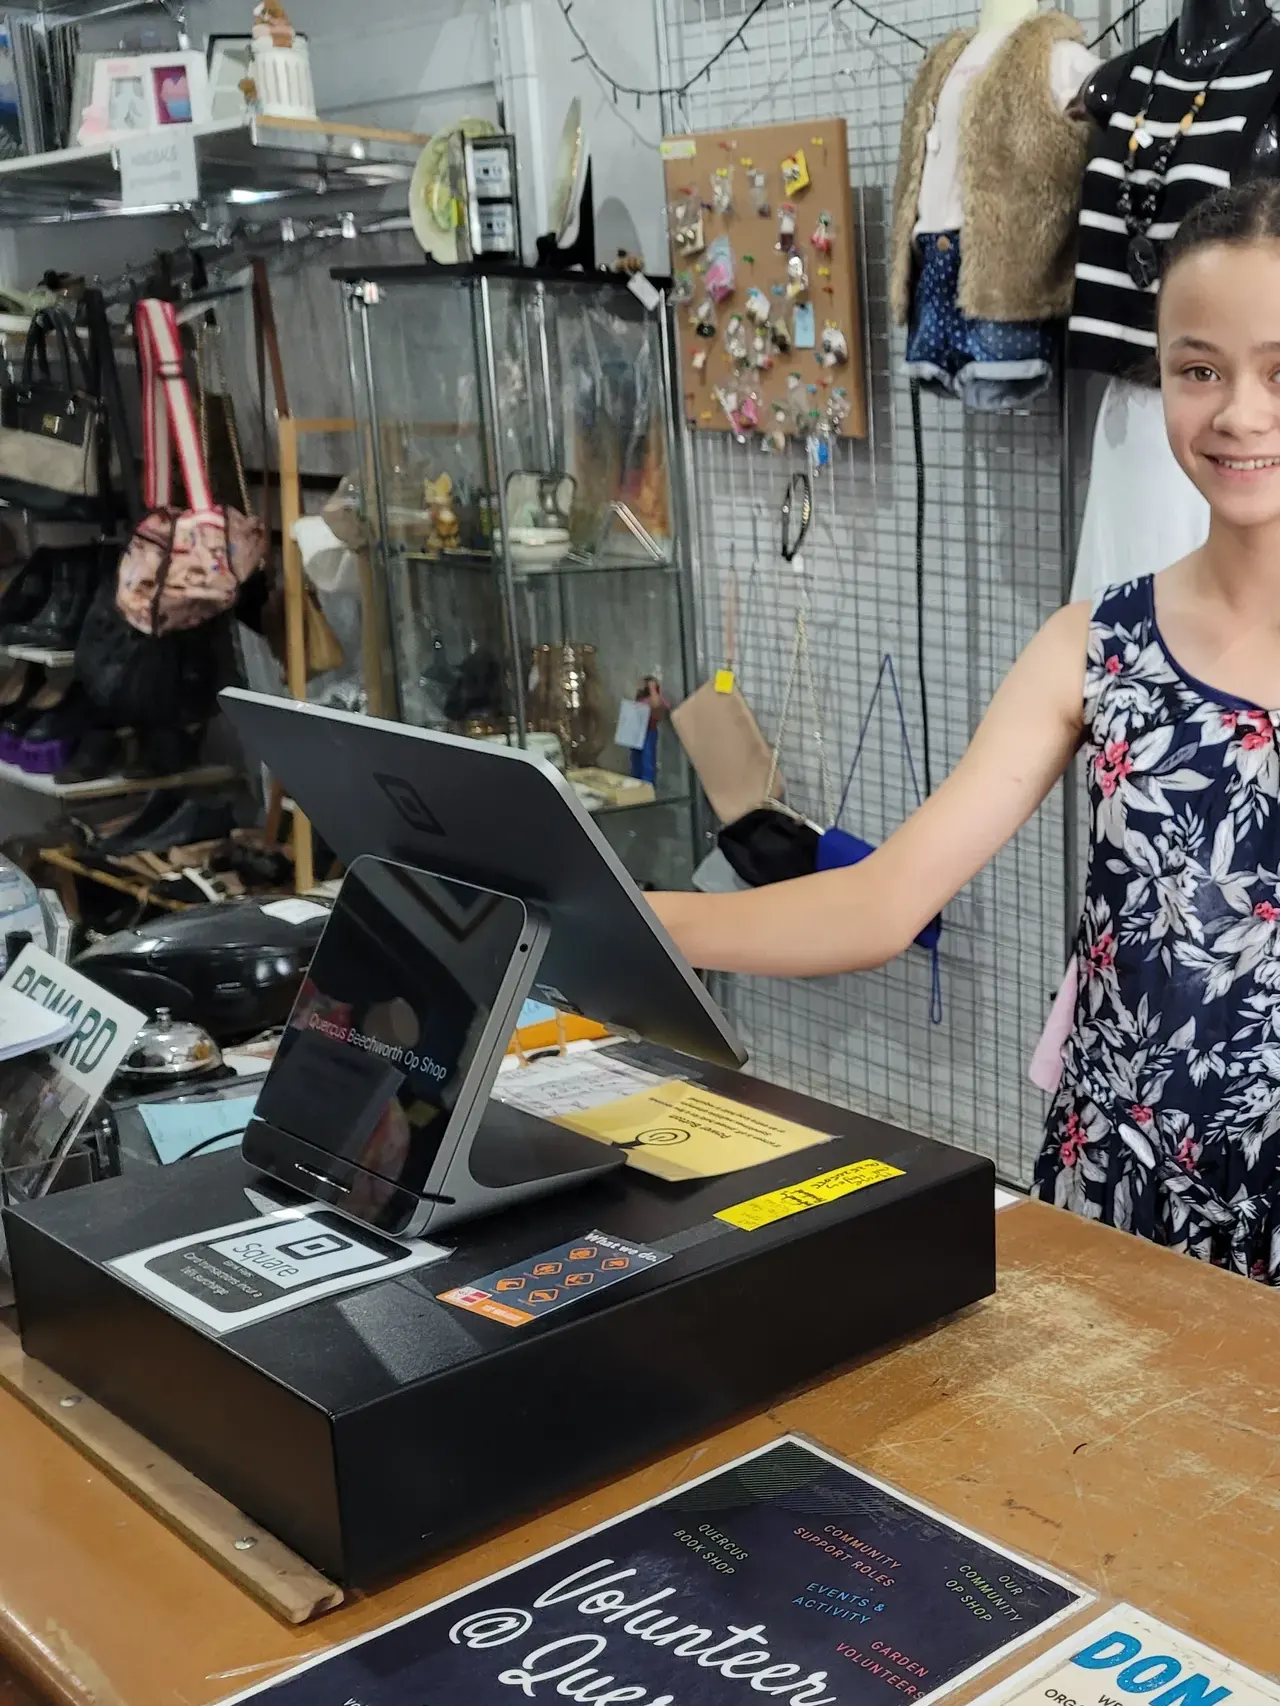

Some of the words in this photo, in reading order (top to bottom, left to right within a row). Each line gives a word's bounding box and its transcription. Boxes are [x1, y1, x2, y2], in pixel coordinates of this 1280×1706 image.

[309, 1013, 347, 1041] Quercus
[347, 1028, 403, 1062] Beechworth
[404, 1050, 420, 1071] Op
[420, 1056, 447, 1081] Shop
[668, 1114, 702, 1128] Button
[700, 1126, 732, 1140] Power
[233, 1243, 299, 1277] Square
[584, 1233, 620, 1249] What
[619, 1245, 639, 1255] we
[638, 1252, 657, 1262] do.
[673, 1529, 706, 1552] BOOK
[702, 1552, 735, 1574] SHOP
[698, 1524, 748, 1560] QUERCUS
[793, 1527, 852, 1561] SUPPORT
[851, 1560, 895, 1587] ROLES
[823, 1525, 902, 1569] COMMUNITY
[806, 1582, 870, 1607] EVENTS
[874, 1603, 885, 1612] &
[945, 1580, 964, 1593] OP
[960, 1595, 992, 1621] SHOP
[959, 1565, 1023, 1621] COMMUNITY
[998, 1575, 1023, 1596] OUR
[792, 1596, 871, 1624] ACTIVITY
[533, 1559, 838, 1706] Volunteer
[448, 1607, 533, 1649] @
[497, 1634, 674, 1706] Que
[836, 1642, 925, 1701] VOLUNTEERS
[871, 1641, 929, 1678] GARDEN
